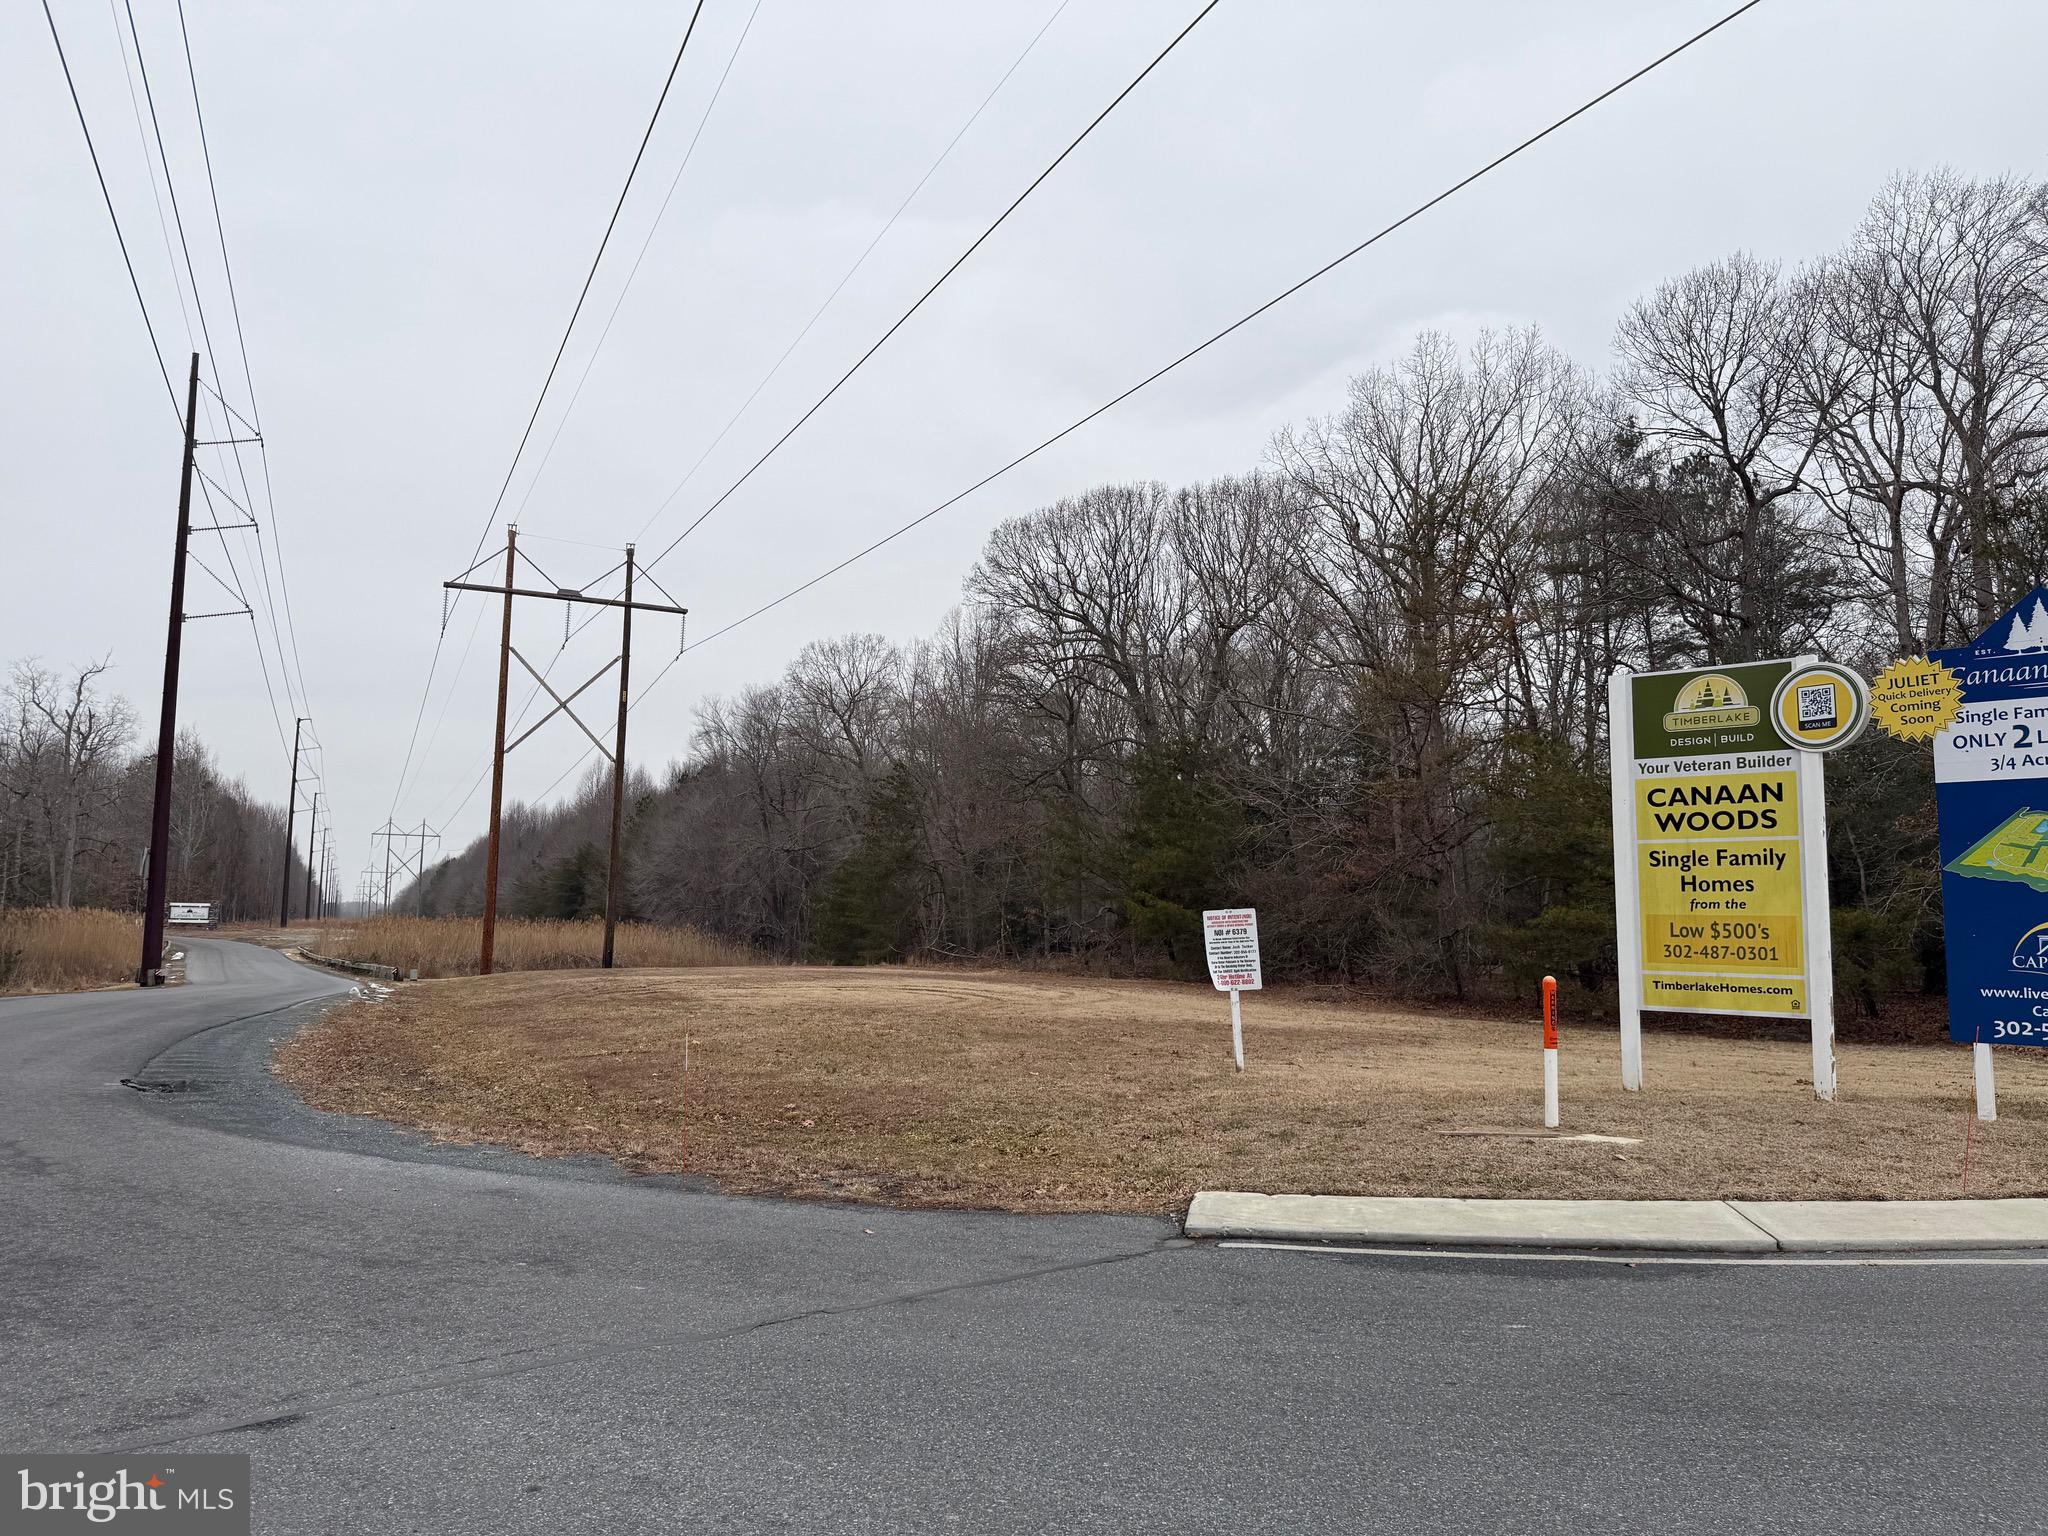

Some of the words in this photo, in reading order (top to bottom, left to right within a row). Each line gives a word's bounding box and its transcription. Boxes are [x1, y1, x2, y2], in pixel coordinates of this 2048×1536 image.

[1887, 674, 1940, 690] JULIET
[1878, 692, 1907, 702] Quick
[1909, 688, 1952, 702] Delivery
[1890, 700, 1941, 713] Coming
[1672, 712, 1750, 726] TIMBERLAKE
[1900, 714, 1934, 726] Soon
[1955, 708, 2008, 726] Single
[1670, 736, 1712, 747] DESIGN
[1721, 734, 1754, 744] BUILD
[1952, 732, 2007, 749] ONLY
[2012, 724, 2032, 748] 2
[1638, 762, 1670, 774] Your
[1674, 759, 1731, 773] Veteran
[1736, 754, 1792, 770] Builder
[1990, 755, 2016, 772] 3/4
[1647, 782, 1784, 808] CANAAN
[1654, 809, 1778, 832] WOODS
[1648, 850, 1709, 872] Single
[1716, 848, 1786, 870] Family
[1681, 875, 1755, 892] Homes
[1690, 898, 1720, 912] from
[1725, 899, 1747, 910] the
[1670, 922, 1704, 938] Low
[1710, 921, 1770, 940] $500's
[1664, 944, 1778, 961] 302-487-0301
[1652, 980, 1793, 996] TimberlakeHomes.com
